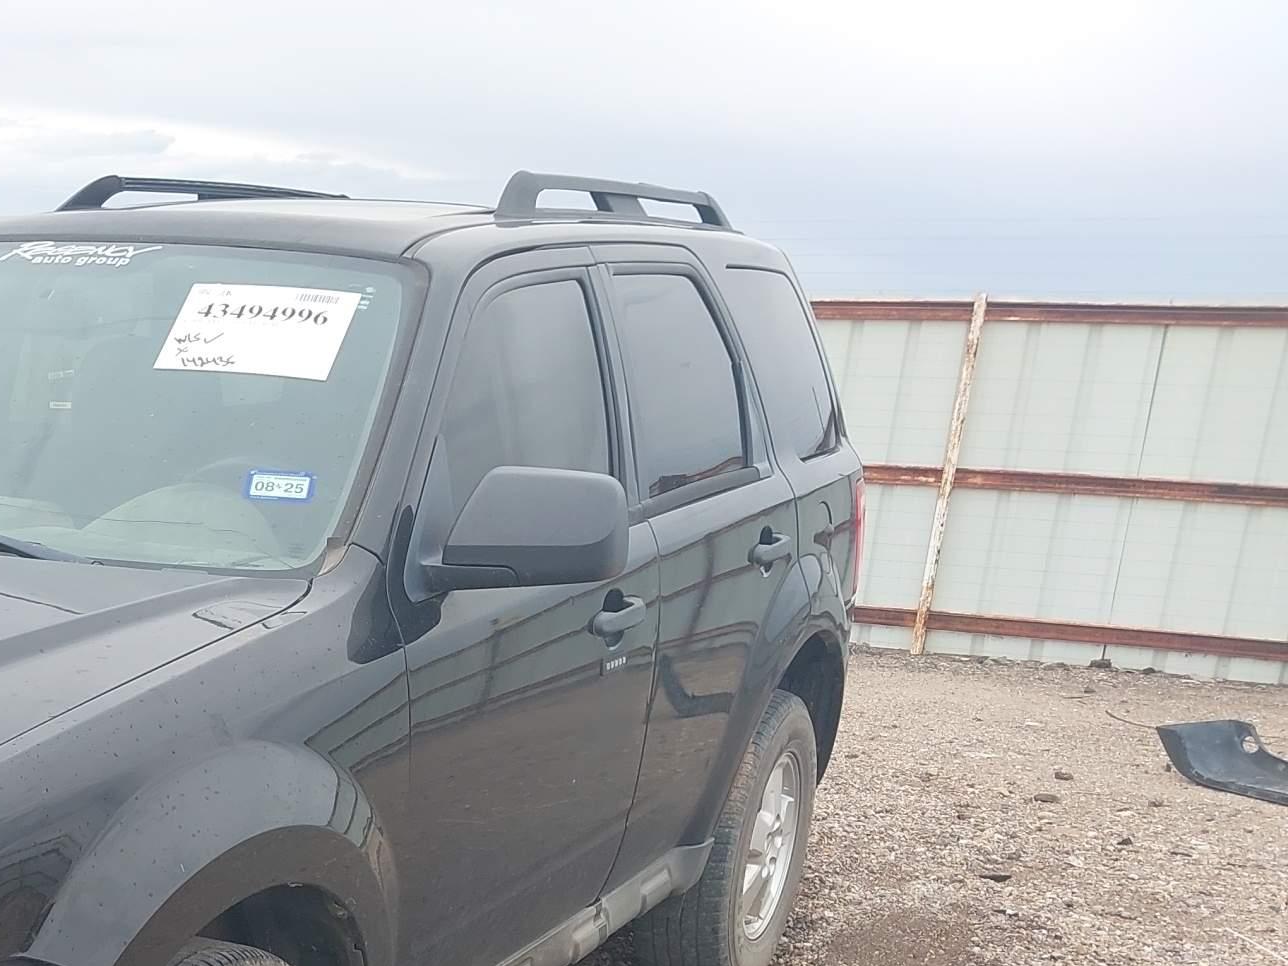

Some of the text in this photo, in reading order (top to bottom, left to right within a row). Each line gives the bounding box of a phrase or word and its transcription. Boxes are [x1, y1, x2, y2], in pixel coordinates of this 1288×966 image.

[31, 253, 130, 267] auto group
[197, 302, 328, 326] 43494996
[283, 482, 305, 494] 25
